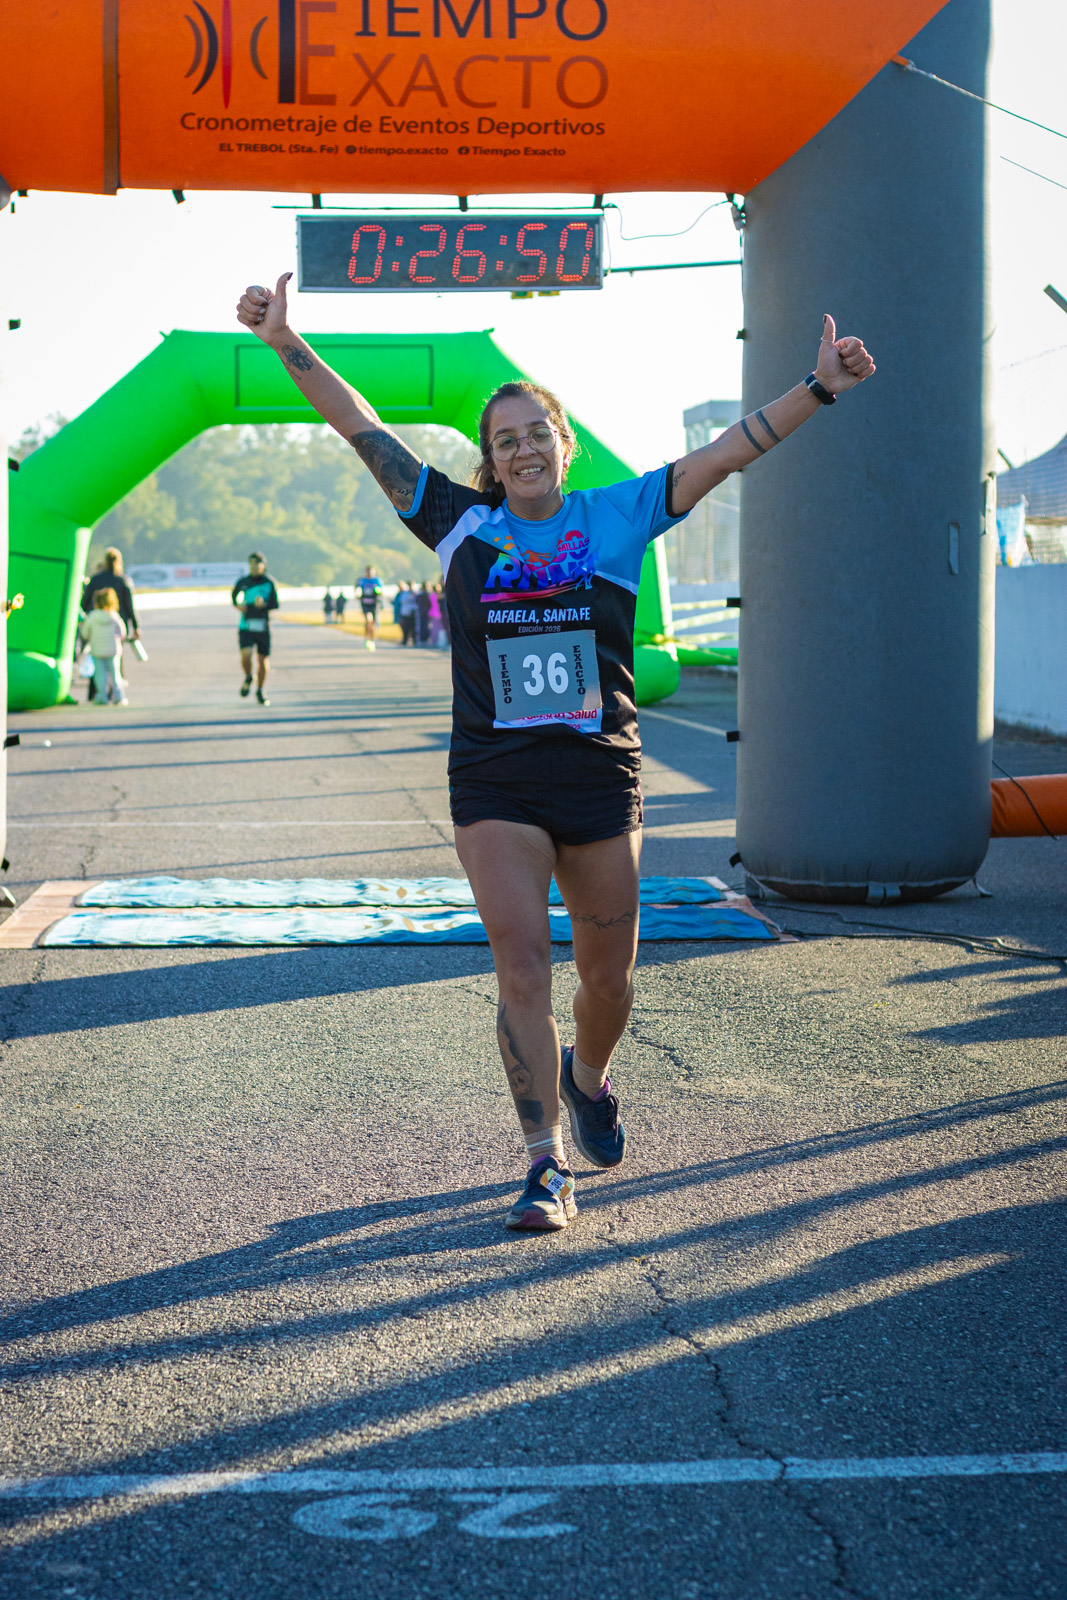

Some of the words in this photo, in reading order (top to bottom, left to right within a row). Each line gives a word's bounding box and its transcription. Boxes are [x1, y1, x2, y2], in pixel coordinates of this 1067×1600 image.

[180, 112, 338, 136] Cronometraje
[343, 115, 372, 133] de
[379, 116, 470, 134] Eventos
[477, 117, 605, 138] Deportivos
[219, 143, 234, 152] EL
[236, 143, 286, 153] TREBOL
[288, 144, 317, 154] (Sta.
[319, 145, 339, 155] Fe)
[472, 146, 521, 157] Tiempo
[523, 147, 566, 156] Exacto
[348, 223, 594, 284] 0:26:50
[557, 537, 590, 552] MILLAS
[487, 609, 540, 624] RAFAELA,
[518, 625, 544, 634] EDICIÓN
[499, 654, 512, 704] TIEMPO
[522, 652, 569, 696] 36
[573, 645, 586, 695] EXACTO
